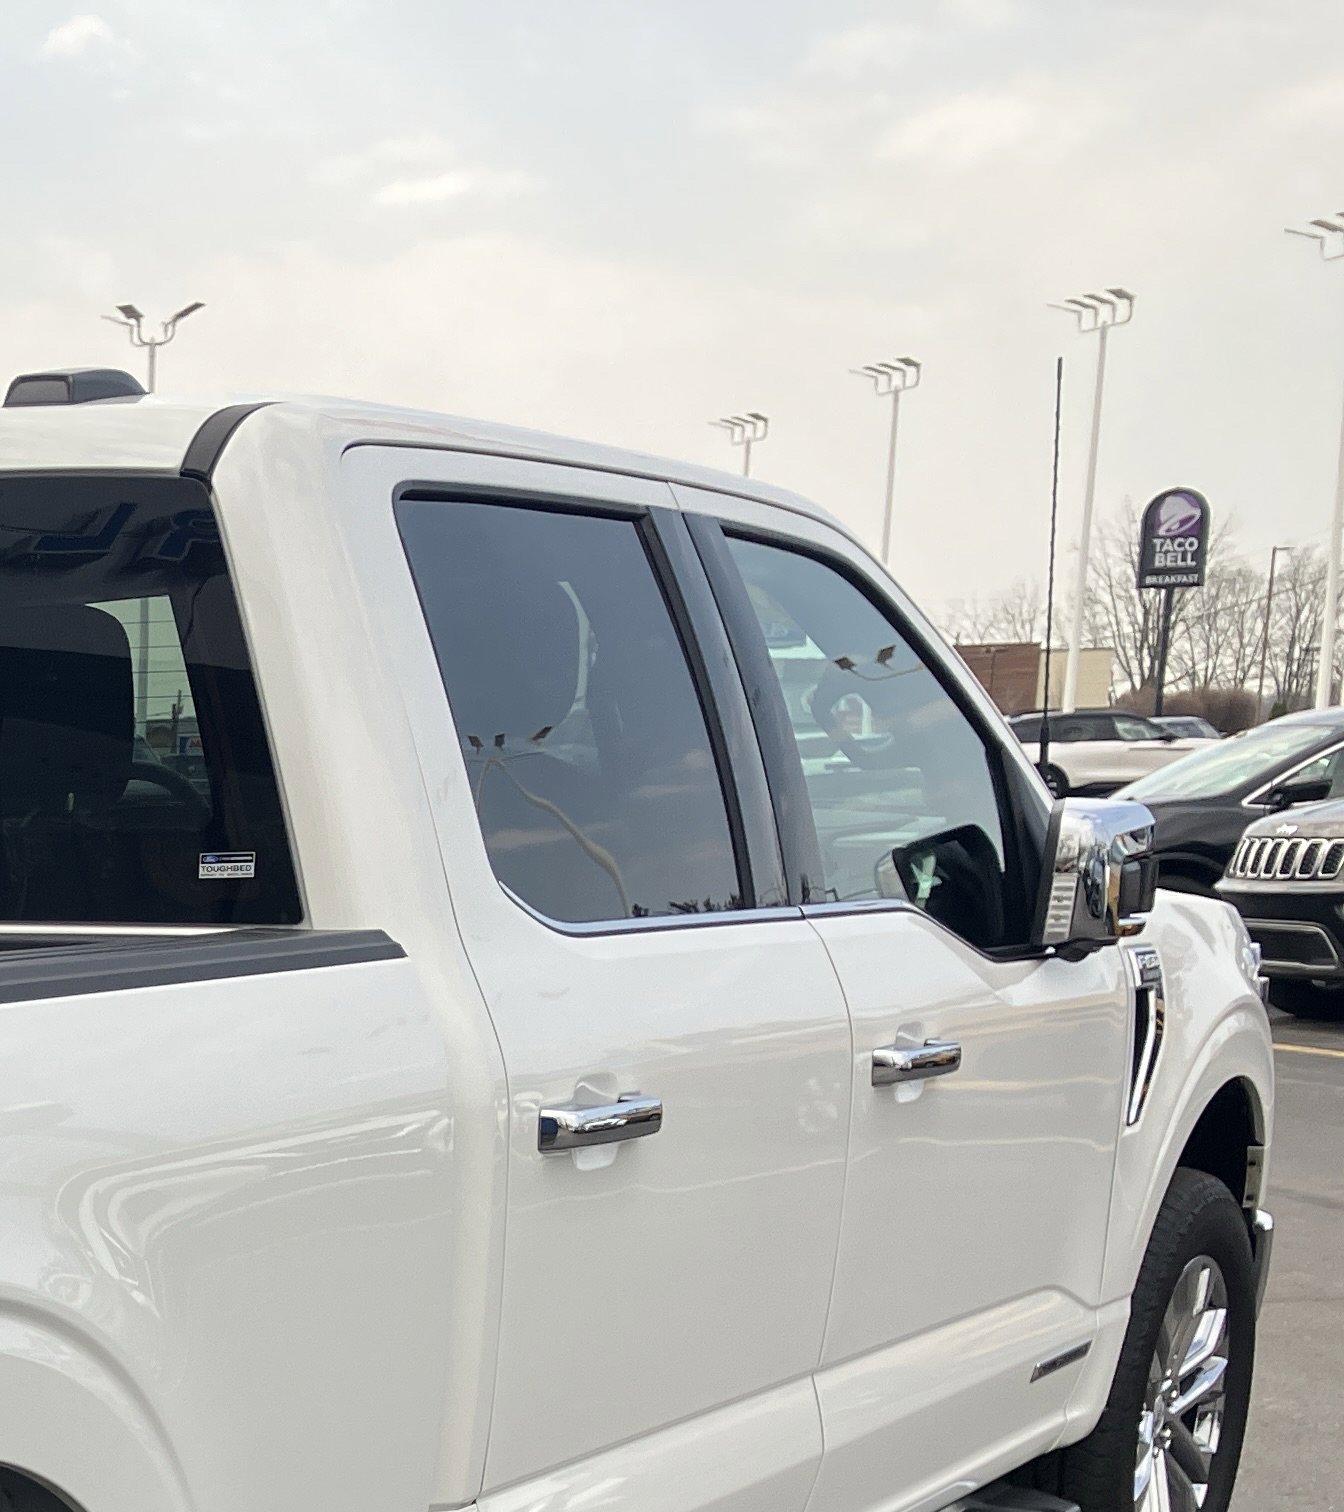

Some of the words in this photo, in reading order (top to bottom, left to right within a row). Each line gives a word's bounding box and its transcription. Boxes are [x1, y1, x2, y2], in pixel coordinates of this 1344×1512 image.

[1152, 537, 1199, 552] TACO
[1154, 552, 1196, 568] BELL
[1145, 574, 1199, 584] BREAKFAST
